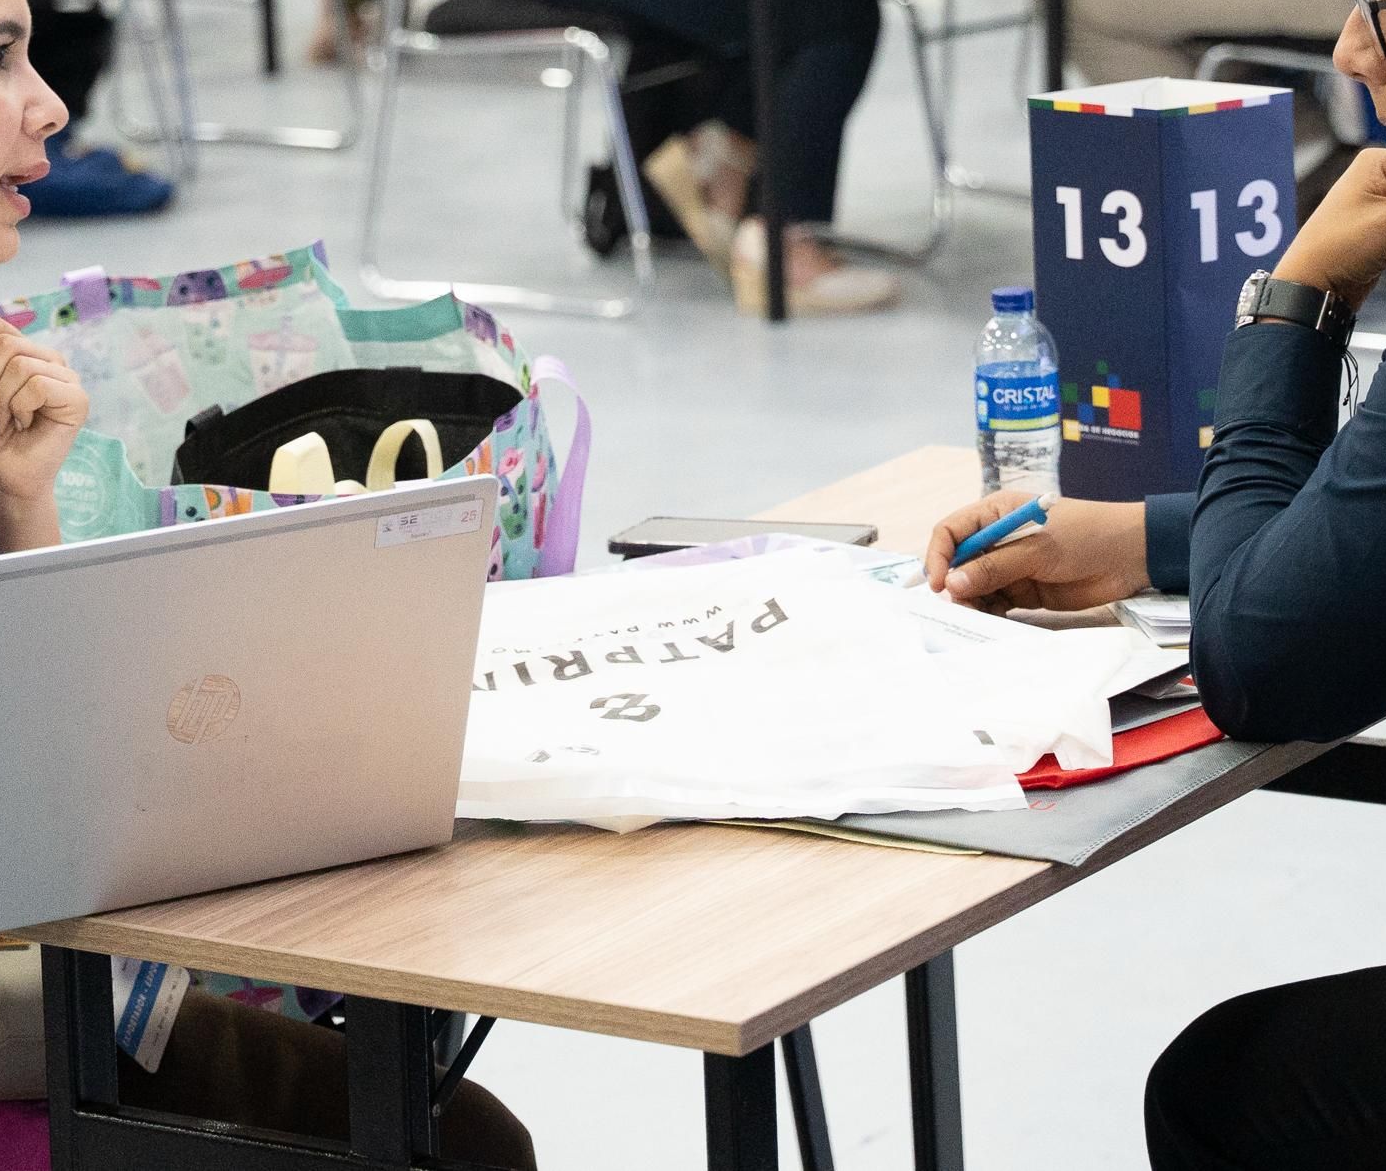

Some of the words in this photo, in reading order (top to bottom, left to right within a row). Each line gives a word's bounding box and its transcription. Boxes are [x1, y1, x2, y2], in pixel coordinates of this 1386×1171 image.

[1055, 186, 1148, 268] 13
[1190, 179, 1284, 264] 13
[992, 385, 1057, 405] CRISTAL
[461, 510, 478, 523] 25
